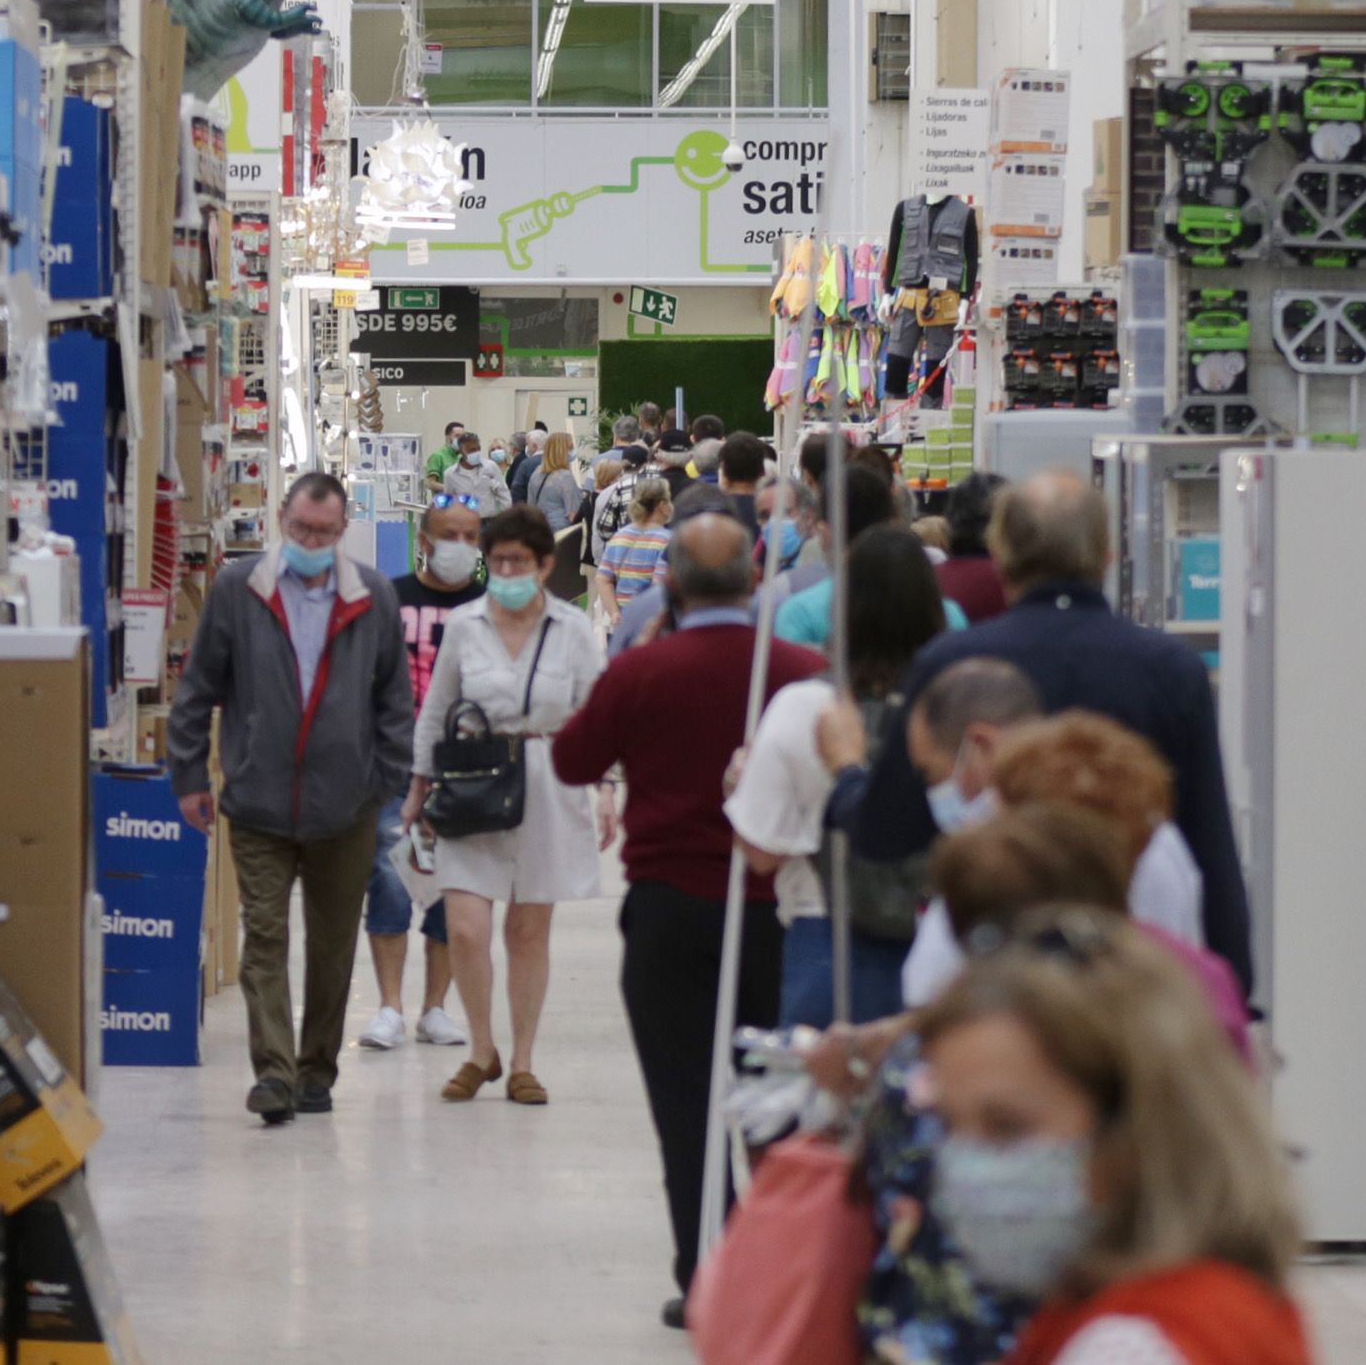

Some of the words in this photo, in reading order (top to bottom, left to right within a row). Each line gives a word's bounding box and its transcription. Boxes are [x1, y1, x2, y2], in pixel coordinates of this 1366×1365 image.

[926, 97, 957, 107] Sierras
[960, 97, 971, 107] de
[926, 112, 967, 123] Lijadoras
[926, 127, 947, 138] Lijas
[743, 139, 828, 167] compr
[229, 163, 261, 180] app
[925, 178, 949, 188] Lixak
[401, 314, 457, 332] 995€
[358, 367, 404, 380] BSICO
[106, 811, 181, 841] simon
[100, 910, 174, 939] simon
[99, 1005, 171, 1032] simon
